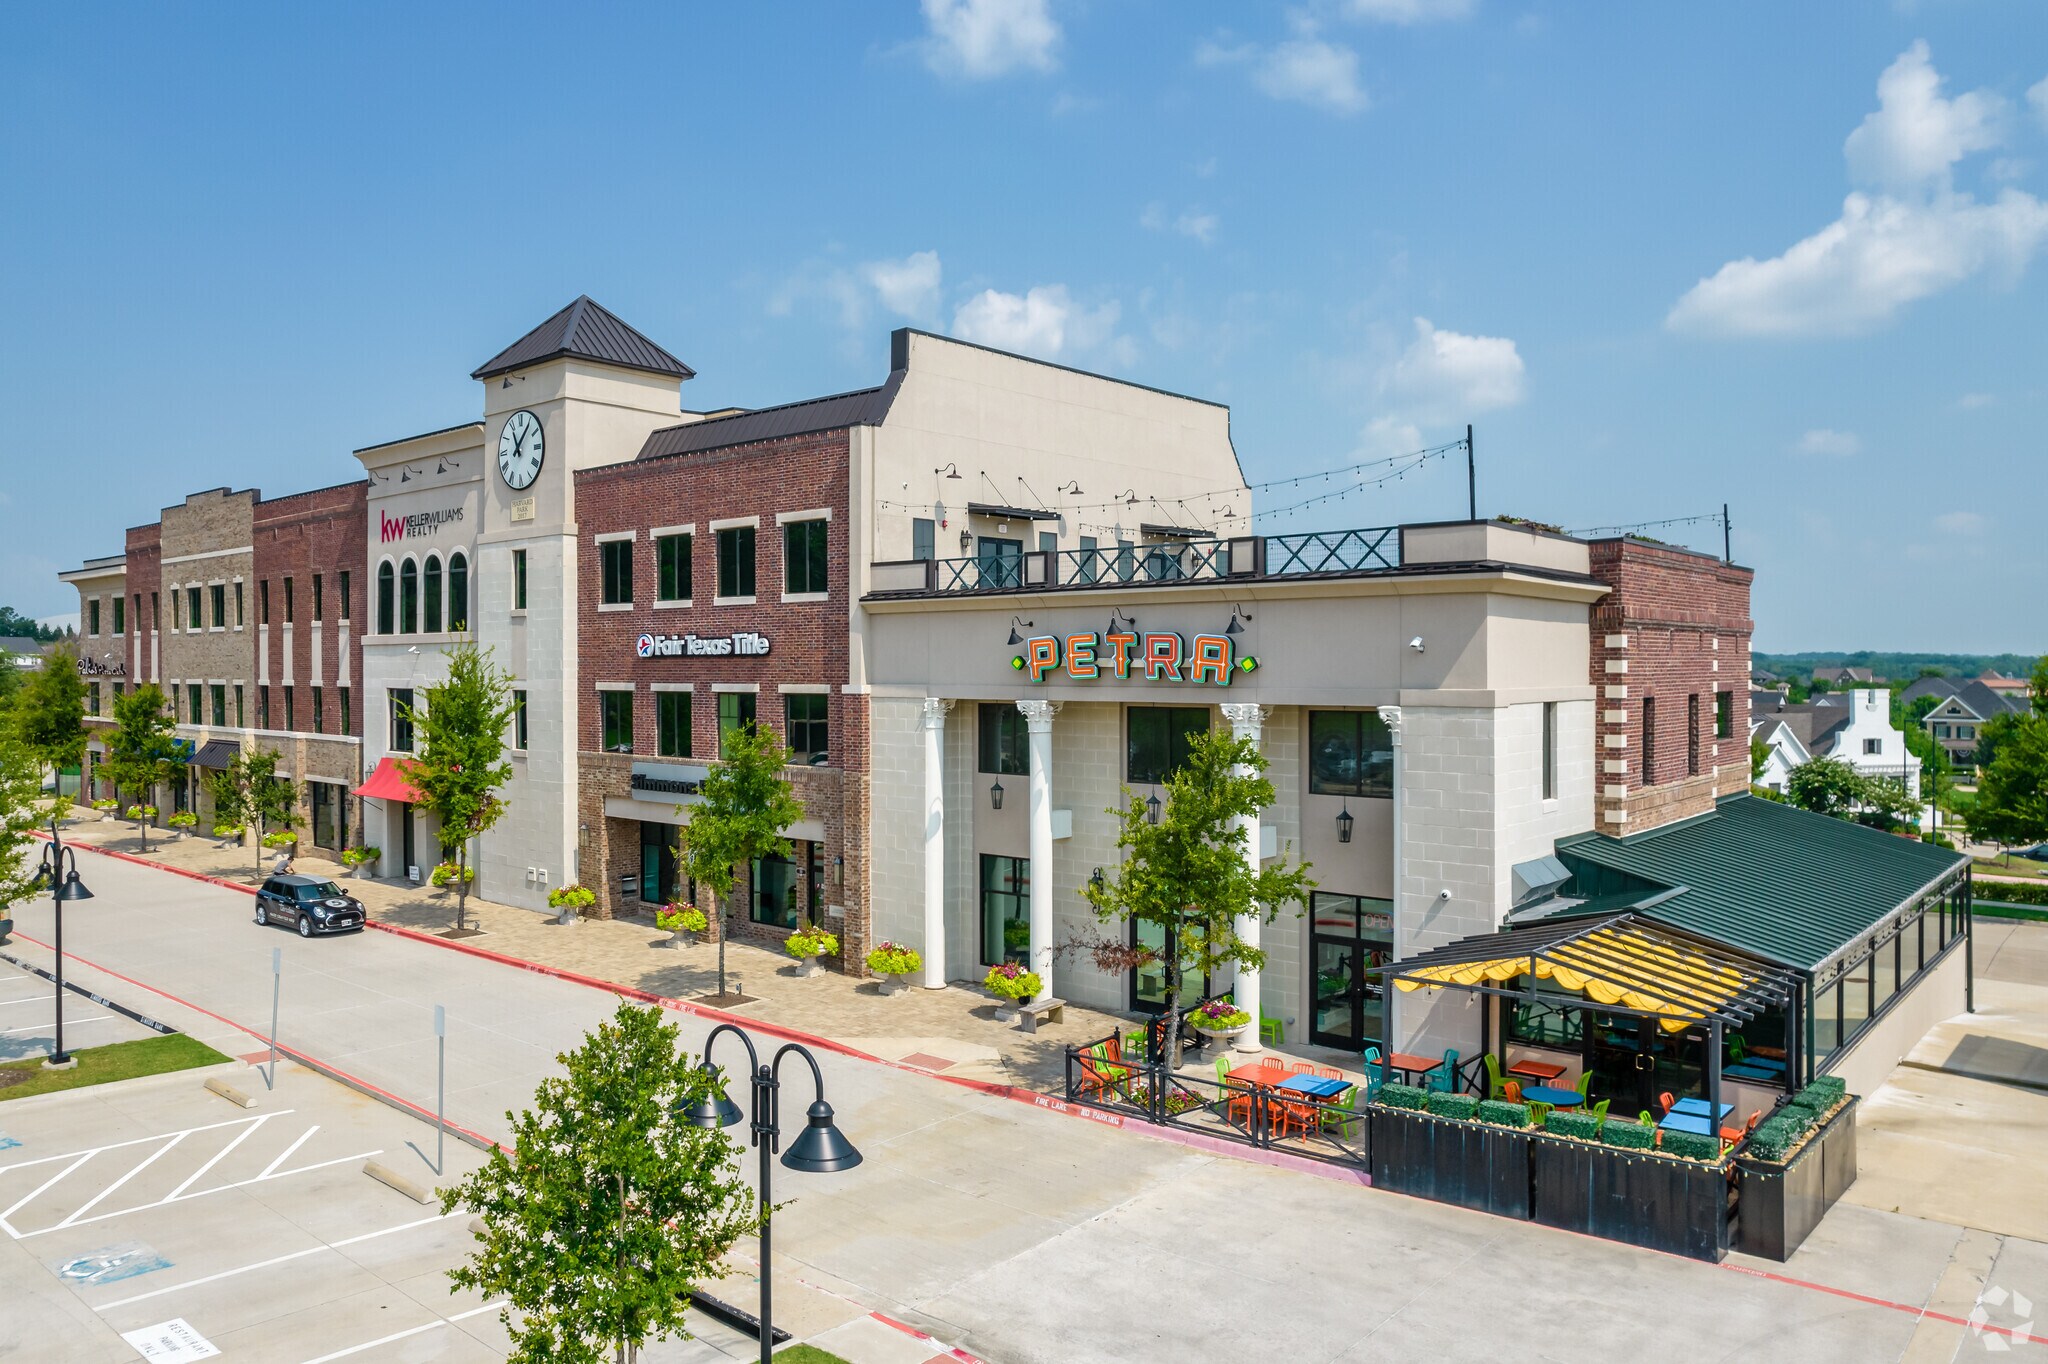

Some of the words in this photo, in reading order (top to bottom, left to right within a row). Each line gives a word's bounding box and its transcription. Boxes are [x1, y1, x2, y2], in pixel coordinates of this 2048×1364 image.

[406, 524, 439, 538] REALTY
[654, 634, 685, 656] Fair
[685, 634, 732, 656] Texas
[732, 632, 770, 656] Title
[1027, 631, 1235, 686] PETRA
[631, 774, 699, 795] Simmons
[1365, 914, 1394, 929] OPEN
[1035, 1097, 1048, 1107] FIRE
[1051, 1100, 1067, 1112] LANE
[1081, 1108, 1090, 1117] NO
[1092, 1112, 1119, 1125] PARKING
